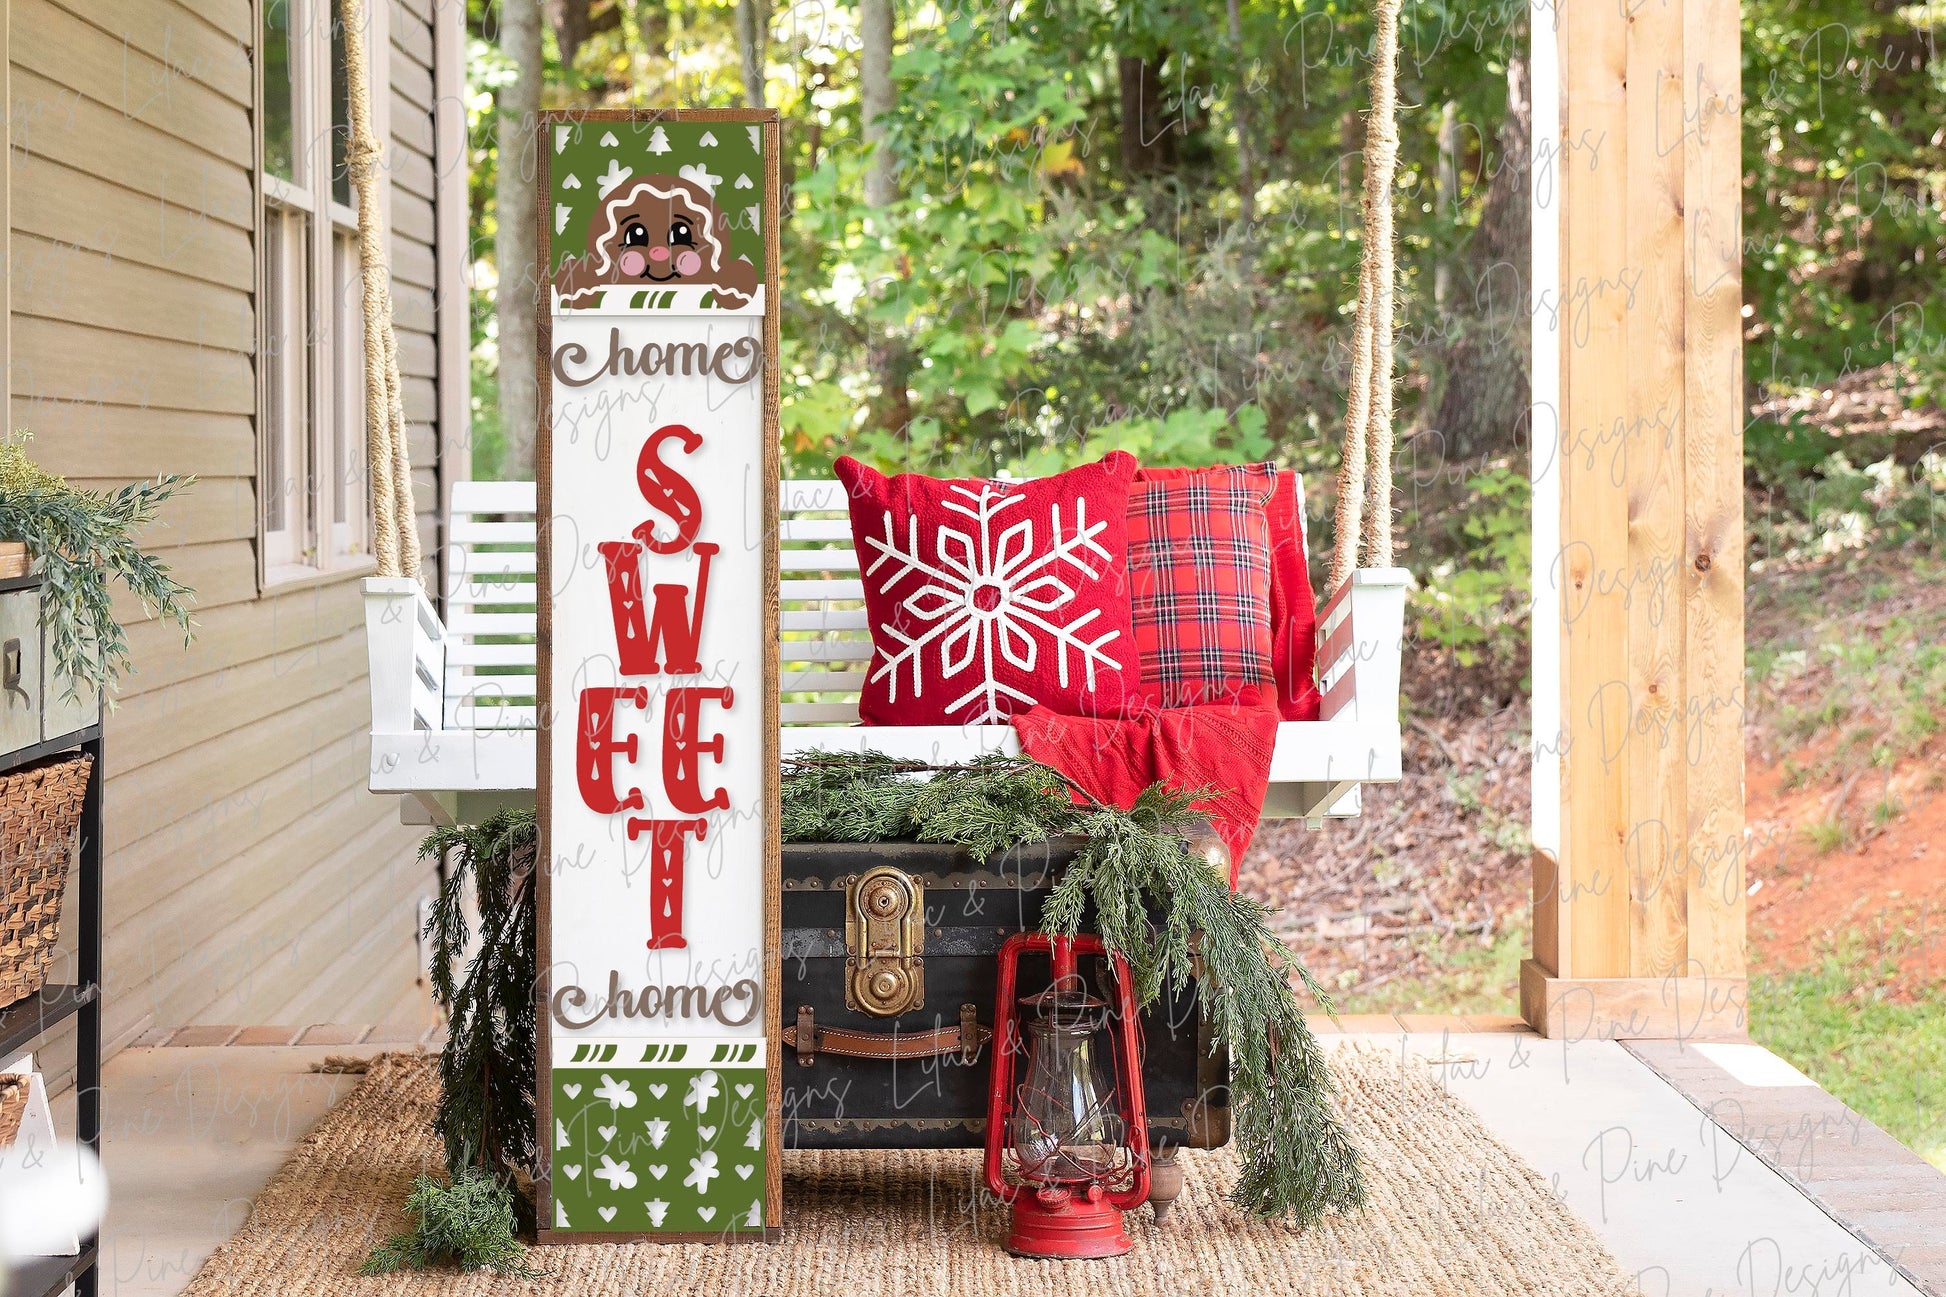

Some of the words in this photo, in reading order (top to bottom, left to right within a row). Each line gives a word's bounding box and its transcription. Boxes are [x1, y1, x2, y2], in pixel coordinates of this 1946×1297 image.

[553, 327, 763, 387] home
[576, 424, 734, 950] SWEET
[553, 970, 762, 1030] home
